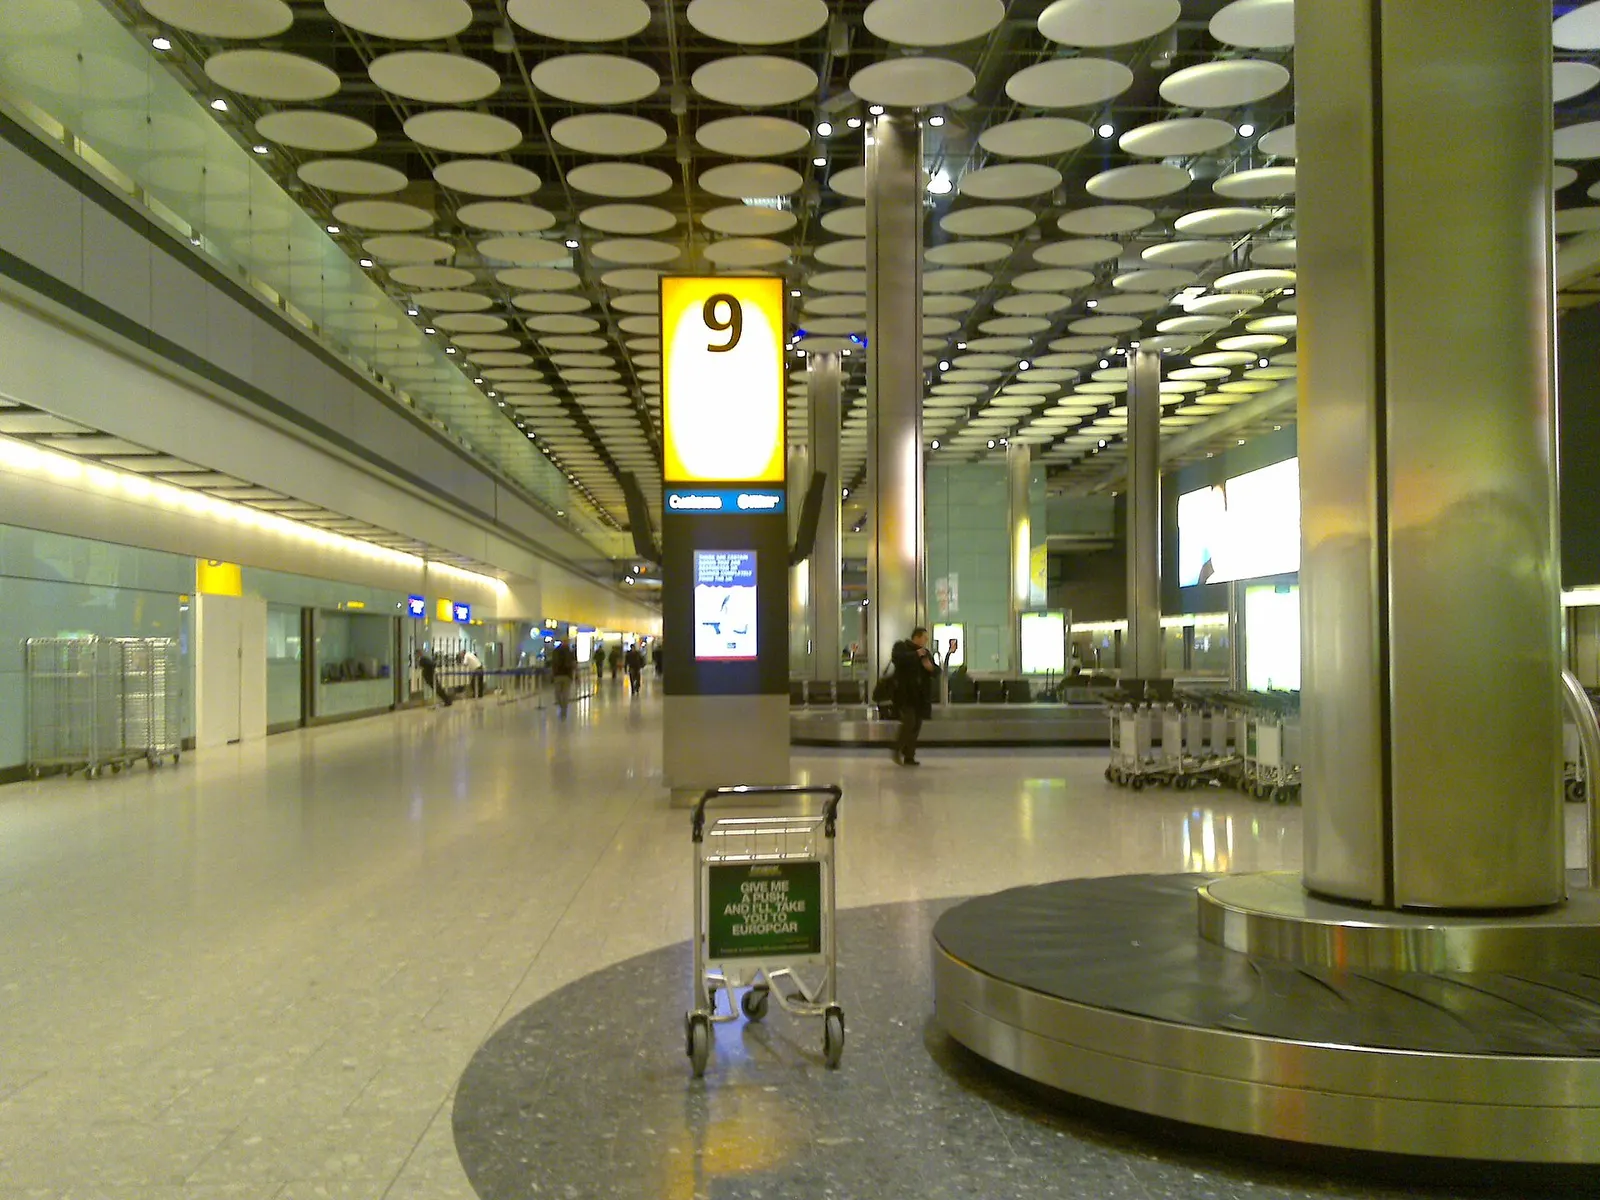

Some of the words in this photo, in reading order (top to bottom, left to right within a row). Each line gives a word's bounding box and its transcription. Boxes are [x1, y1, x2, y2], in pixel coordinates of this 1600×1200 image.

[703, 292, 743, 353] 9
[740, 881, 769, 894] GIVE
[771, 880, 790, 893] ME
[741, 893, 751, 903] A
[724, 903, 750, 916] AND
[775, 900, 806, 914] TAKE
[743, 914, 769, 925] YOU
[771, 912, 788, 923] TO
[732, 922, 799, 937] EUROPCAR
